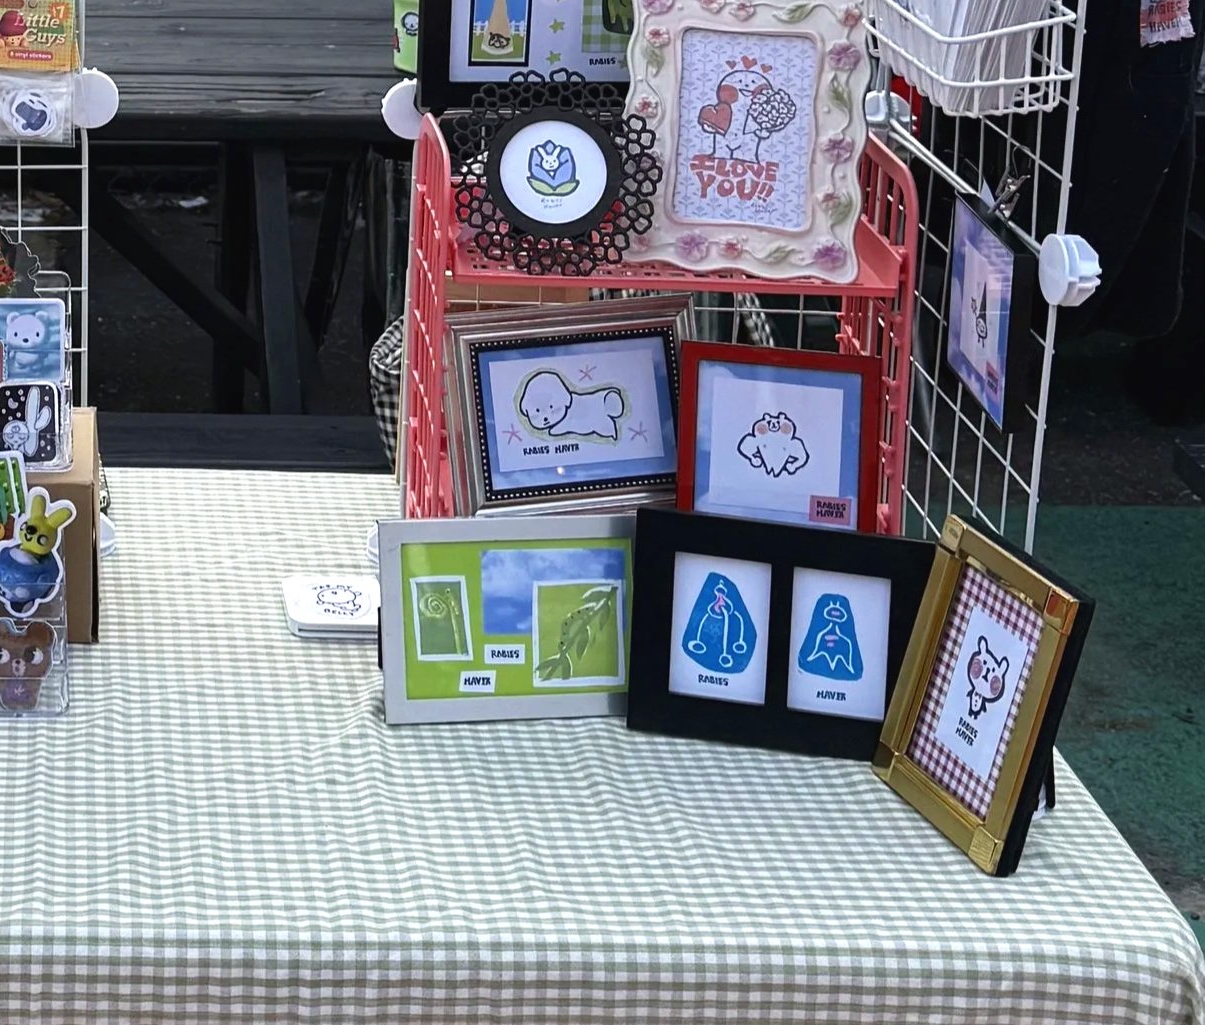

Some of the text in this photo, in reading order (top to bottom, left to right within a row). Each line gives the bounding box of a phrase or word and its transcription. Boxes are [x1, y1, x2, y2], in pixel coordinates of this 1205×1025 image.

[13, 11, 60, 29] Little
[23, 28, 67, 47] Guys
[589, 57, 617, 66] RABIES
[715, 159, 780, 182] LOVE
[696, 170, 775, 203] YOU!!
[522, 445, 550, 456] RABIES
[816, 500, 847, 512] RABIES
[491, 649, 520, 659] RABIES
[698, 673, 730, 687] RABIES
[816, 690, 847, 702] HAVER
